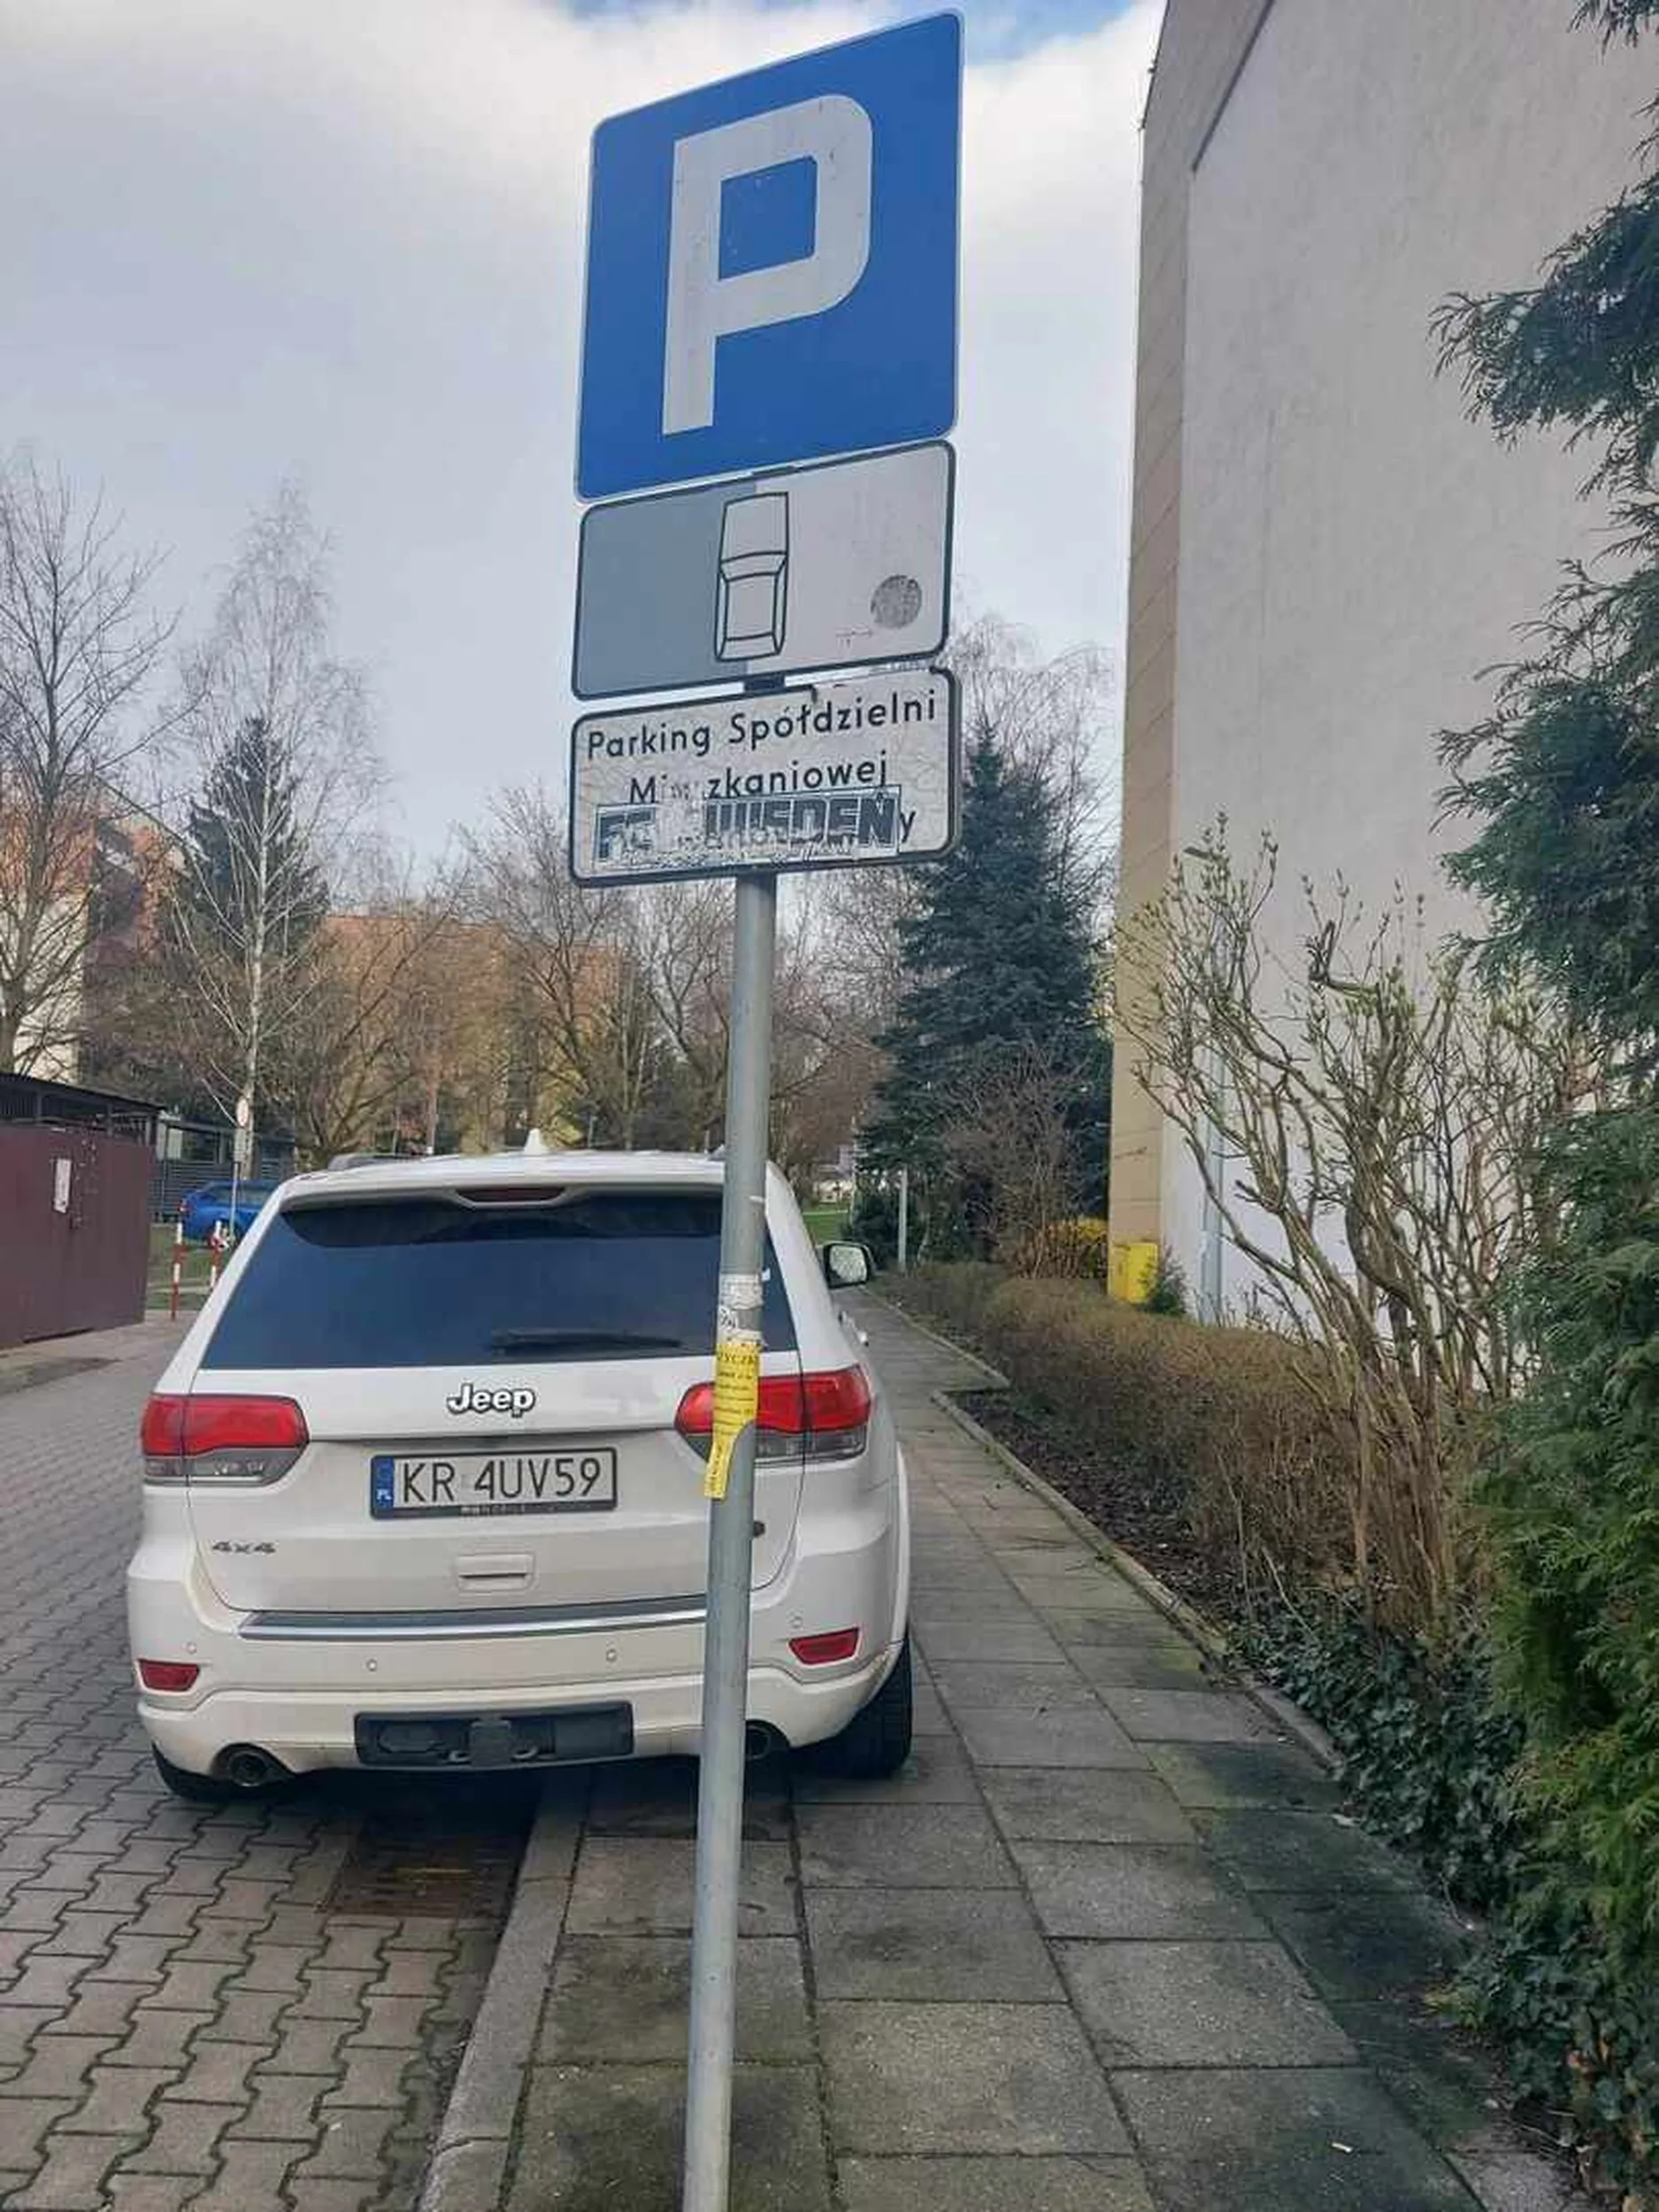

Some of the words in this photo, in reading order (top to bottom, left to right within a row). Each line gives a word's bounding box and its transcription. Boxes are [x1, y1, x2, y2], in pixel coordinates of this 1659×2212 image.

[663, 95, 872, 434] P
[587, 723, 710, 760] Parking
[728, 688, 935, 750] Spółdzielni
[629, 750, 887, 804] Mzkaniowej
[447, 1383, 536, 1417] Jeep
[403, 1462, 455, 1502] KR
[474, 1457, 602, 1500] 4UV59
